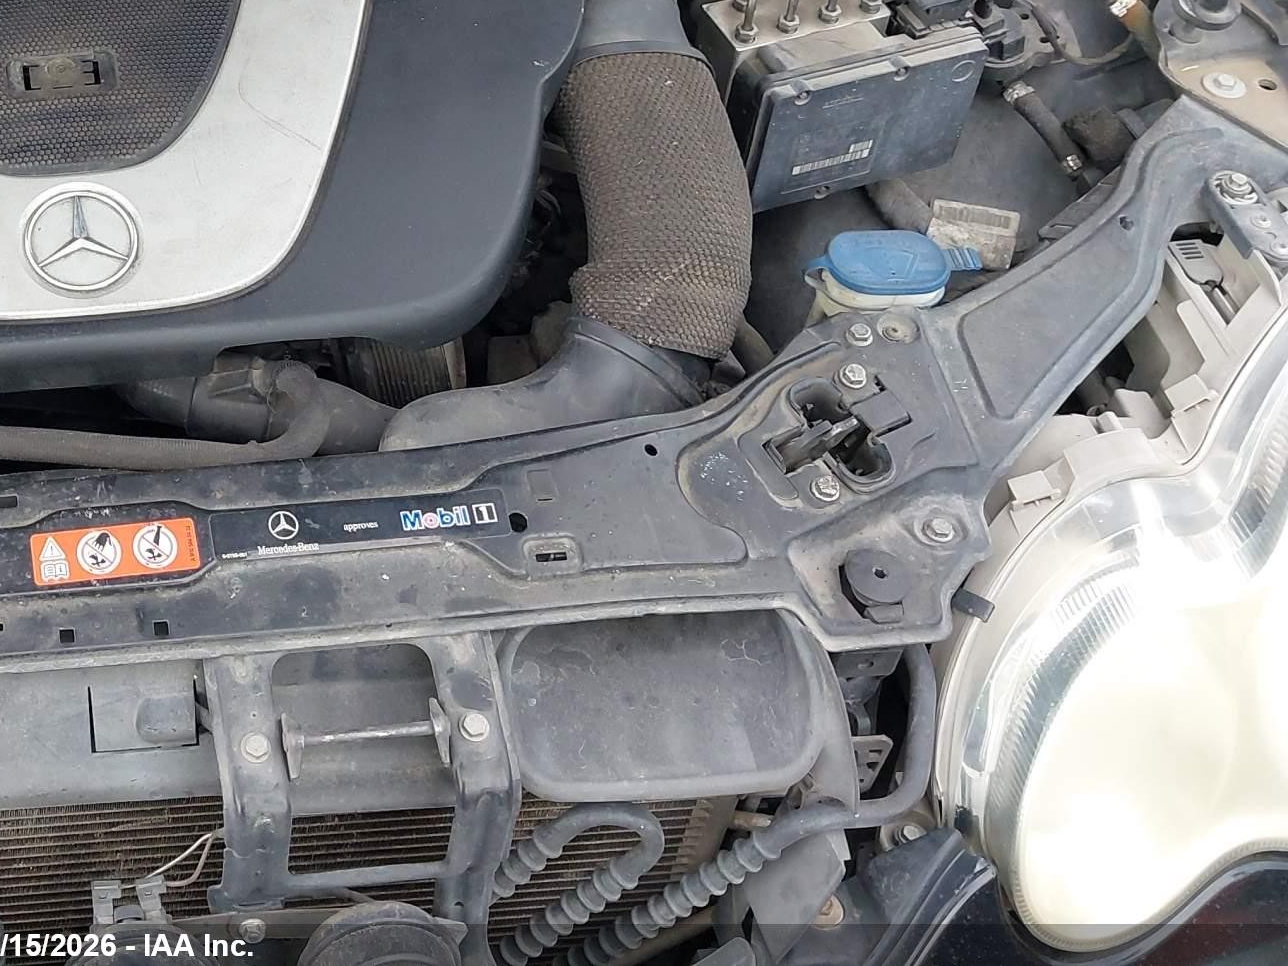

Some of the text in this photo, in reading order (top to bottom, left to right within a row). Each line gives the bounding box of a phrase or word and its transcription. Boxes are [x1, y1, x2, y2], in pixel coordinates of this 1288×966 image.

[343, 521, 379, 533] approves
[400, 506, 470, 531] Mobil
[256, 542, 320, 556] Mercedes-Benz
